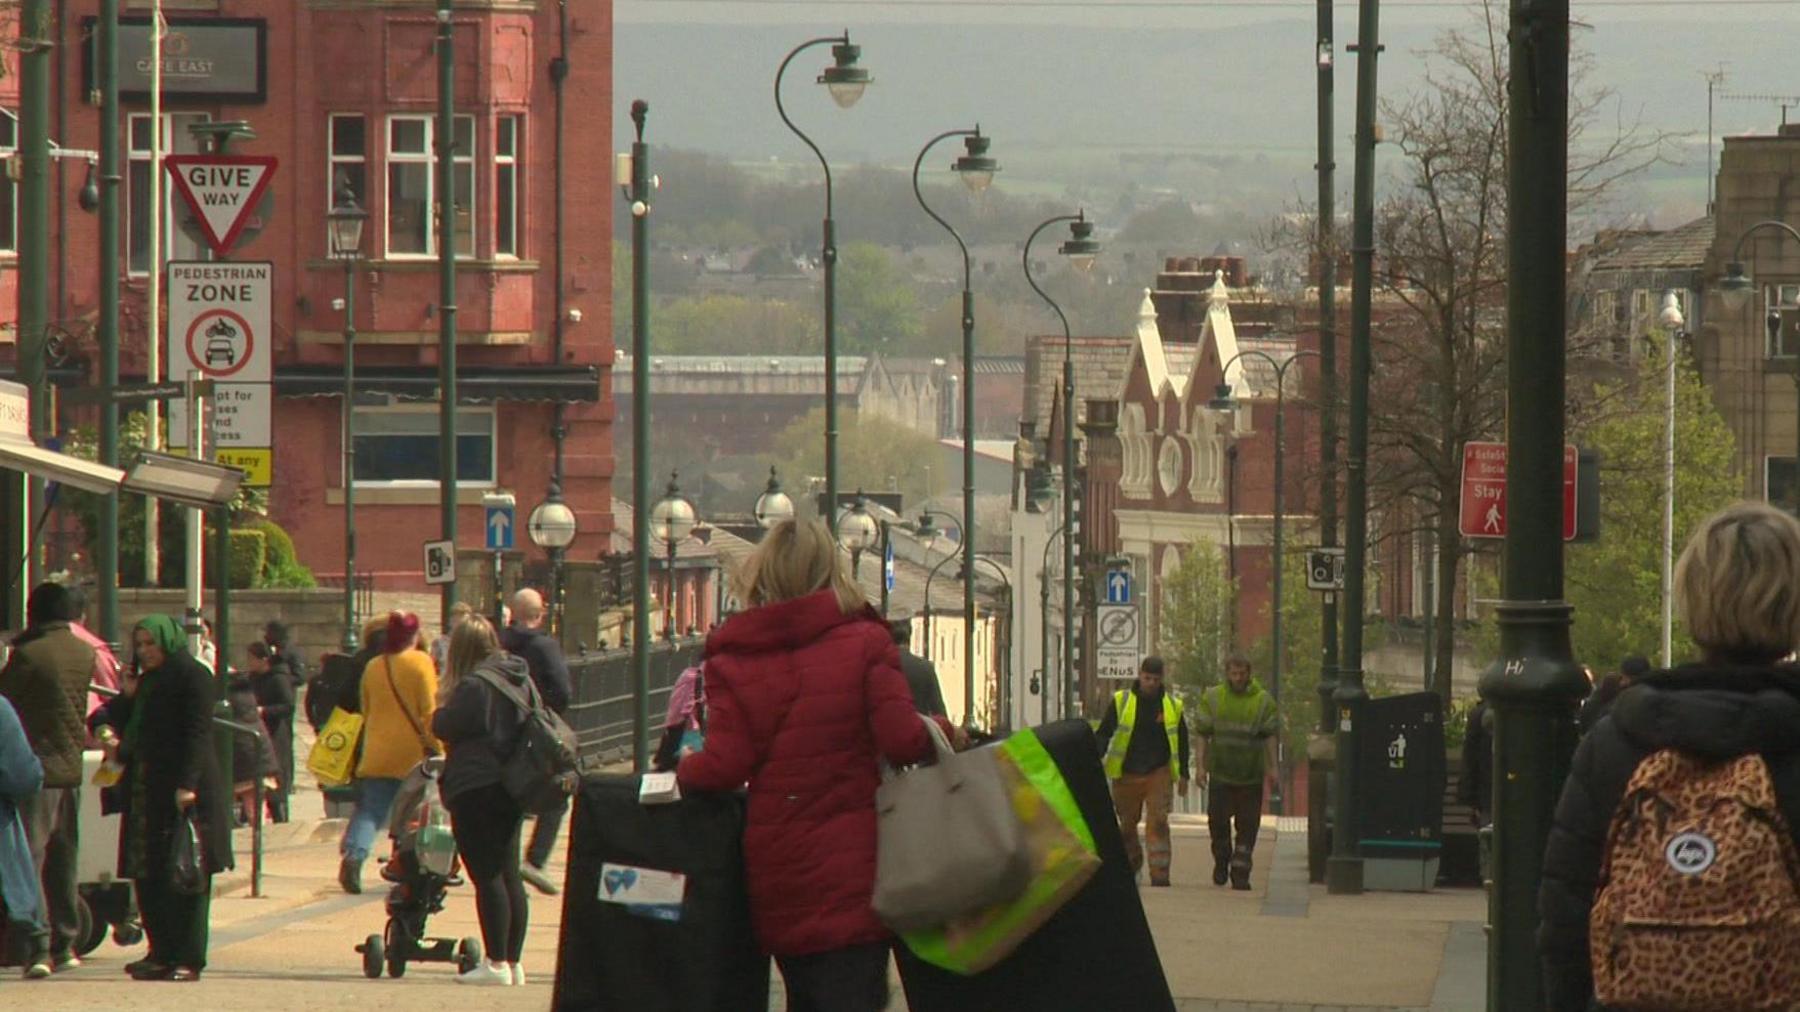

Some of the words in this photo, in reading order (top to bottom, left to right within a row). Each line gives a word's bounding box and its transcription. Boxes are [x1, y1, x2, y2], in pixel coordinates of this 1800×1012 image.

[179, 60, 214, 73] EAST
[189, 167, 250, 187] GIVE
[203, 193, 239, 206] WAY
[174, 267, 267, 279] PEDESTRIAN
[187, 285, 252, 302] ZONE
[235, 391, 253, 401] for
[218, 405, 238, 414] ses
[216, 418, 232, 427] nd
[216, 432, 241, 440] cess
[237, 456, 260, 467] any
[1480, 462, 1505, 473] Socia
[1474, 485, 1502, 501] Stay
